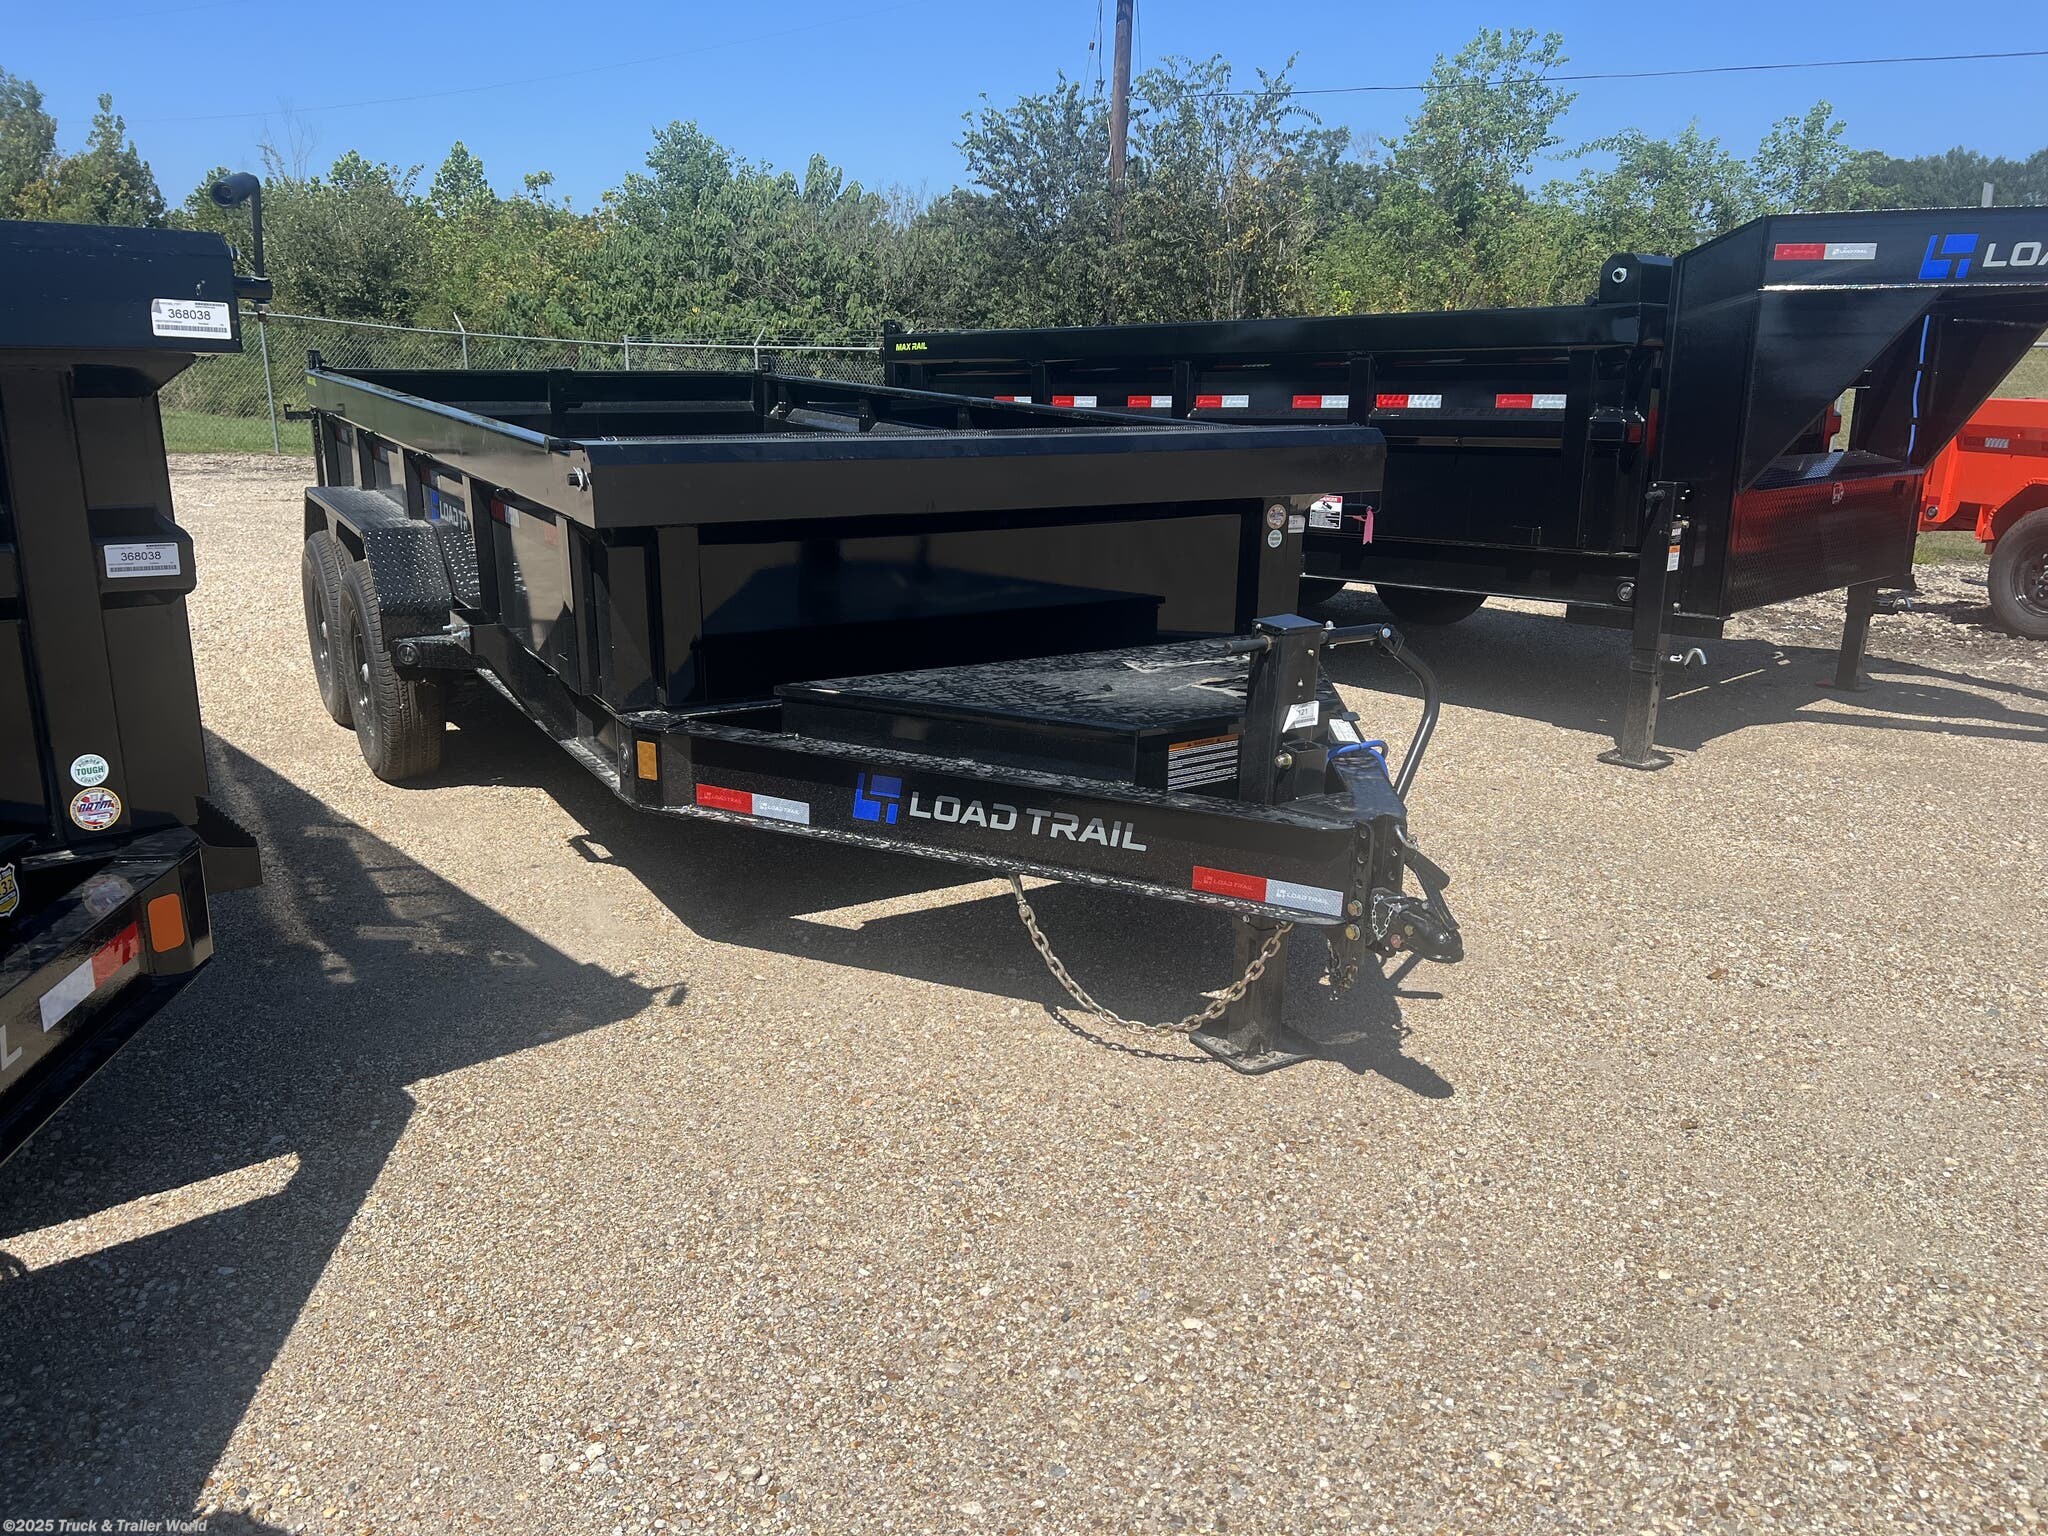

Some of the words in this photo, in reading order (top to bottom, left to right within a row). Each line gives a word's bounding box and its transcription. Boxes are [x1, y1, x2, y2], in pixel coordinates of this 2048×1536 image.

[168, 308, 211, 321] 368038
[895, 343, 911, 351] MAX
[911, 342, 927, 350] RAIL
[439, 500, 459, 527] LOAD
[121, 551, 162, 562] 368038
[76, 766, 104, 776] TOUGH
[909, 791, 1018, 831] LOAD
[1026, 807, 1147, 851] TRAIL
